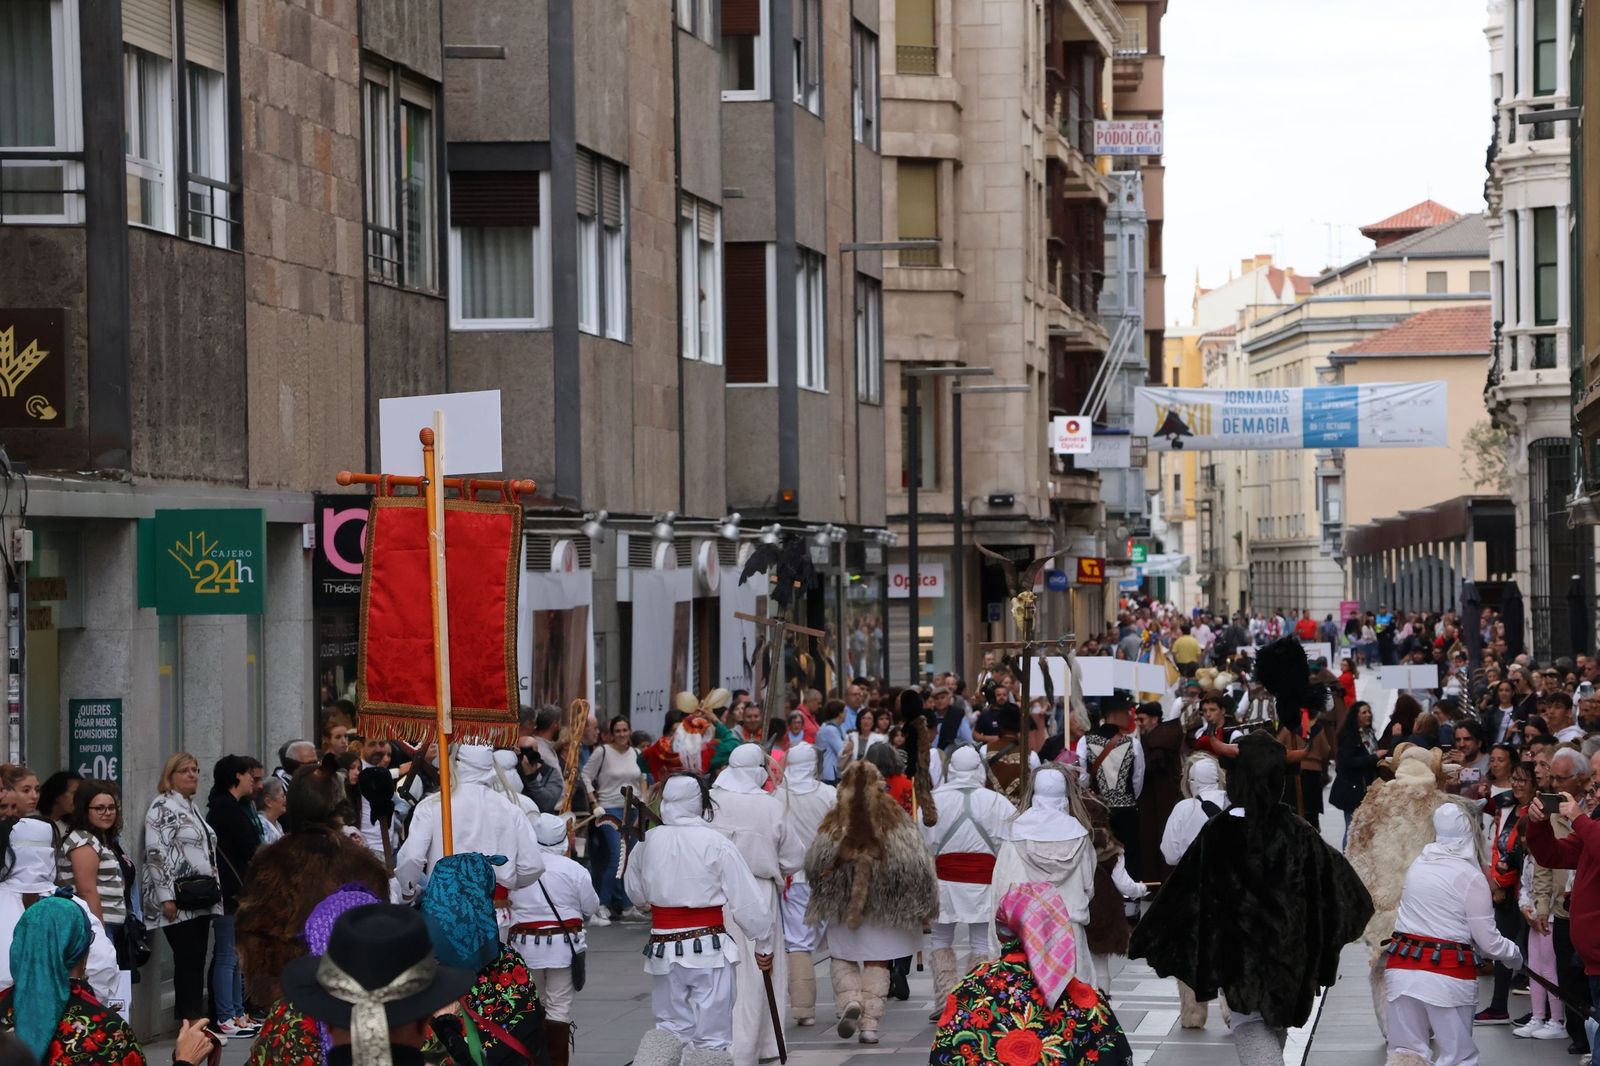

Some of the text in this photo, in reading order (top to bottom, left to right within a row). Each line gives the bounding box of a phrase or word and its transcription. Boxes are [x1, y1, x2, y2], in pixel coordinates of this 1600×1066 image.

[1096, 130, 1161, 145] PODOLOGO
[1224, 389, 1290, 404] JORNADAS
[1222, 406, 1289, 416] INTERNACIONALES
[1222, 416, 1290, 434] DE MAGIA
[211, 550, 253, 558] CAJERO
[195, 559, 254, 593] 24h
[77, 704, 111, 719] ¿QUIERES
[74, 717, 117, 728] PAGAR MENOS
[74, 728, 118, 739] COMISIONES?
[79, 744, 113, 753] EMPIEZA POR
